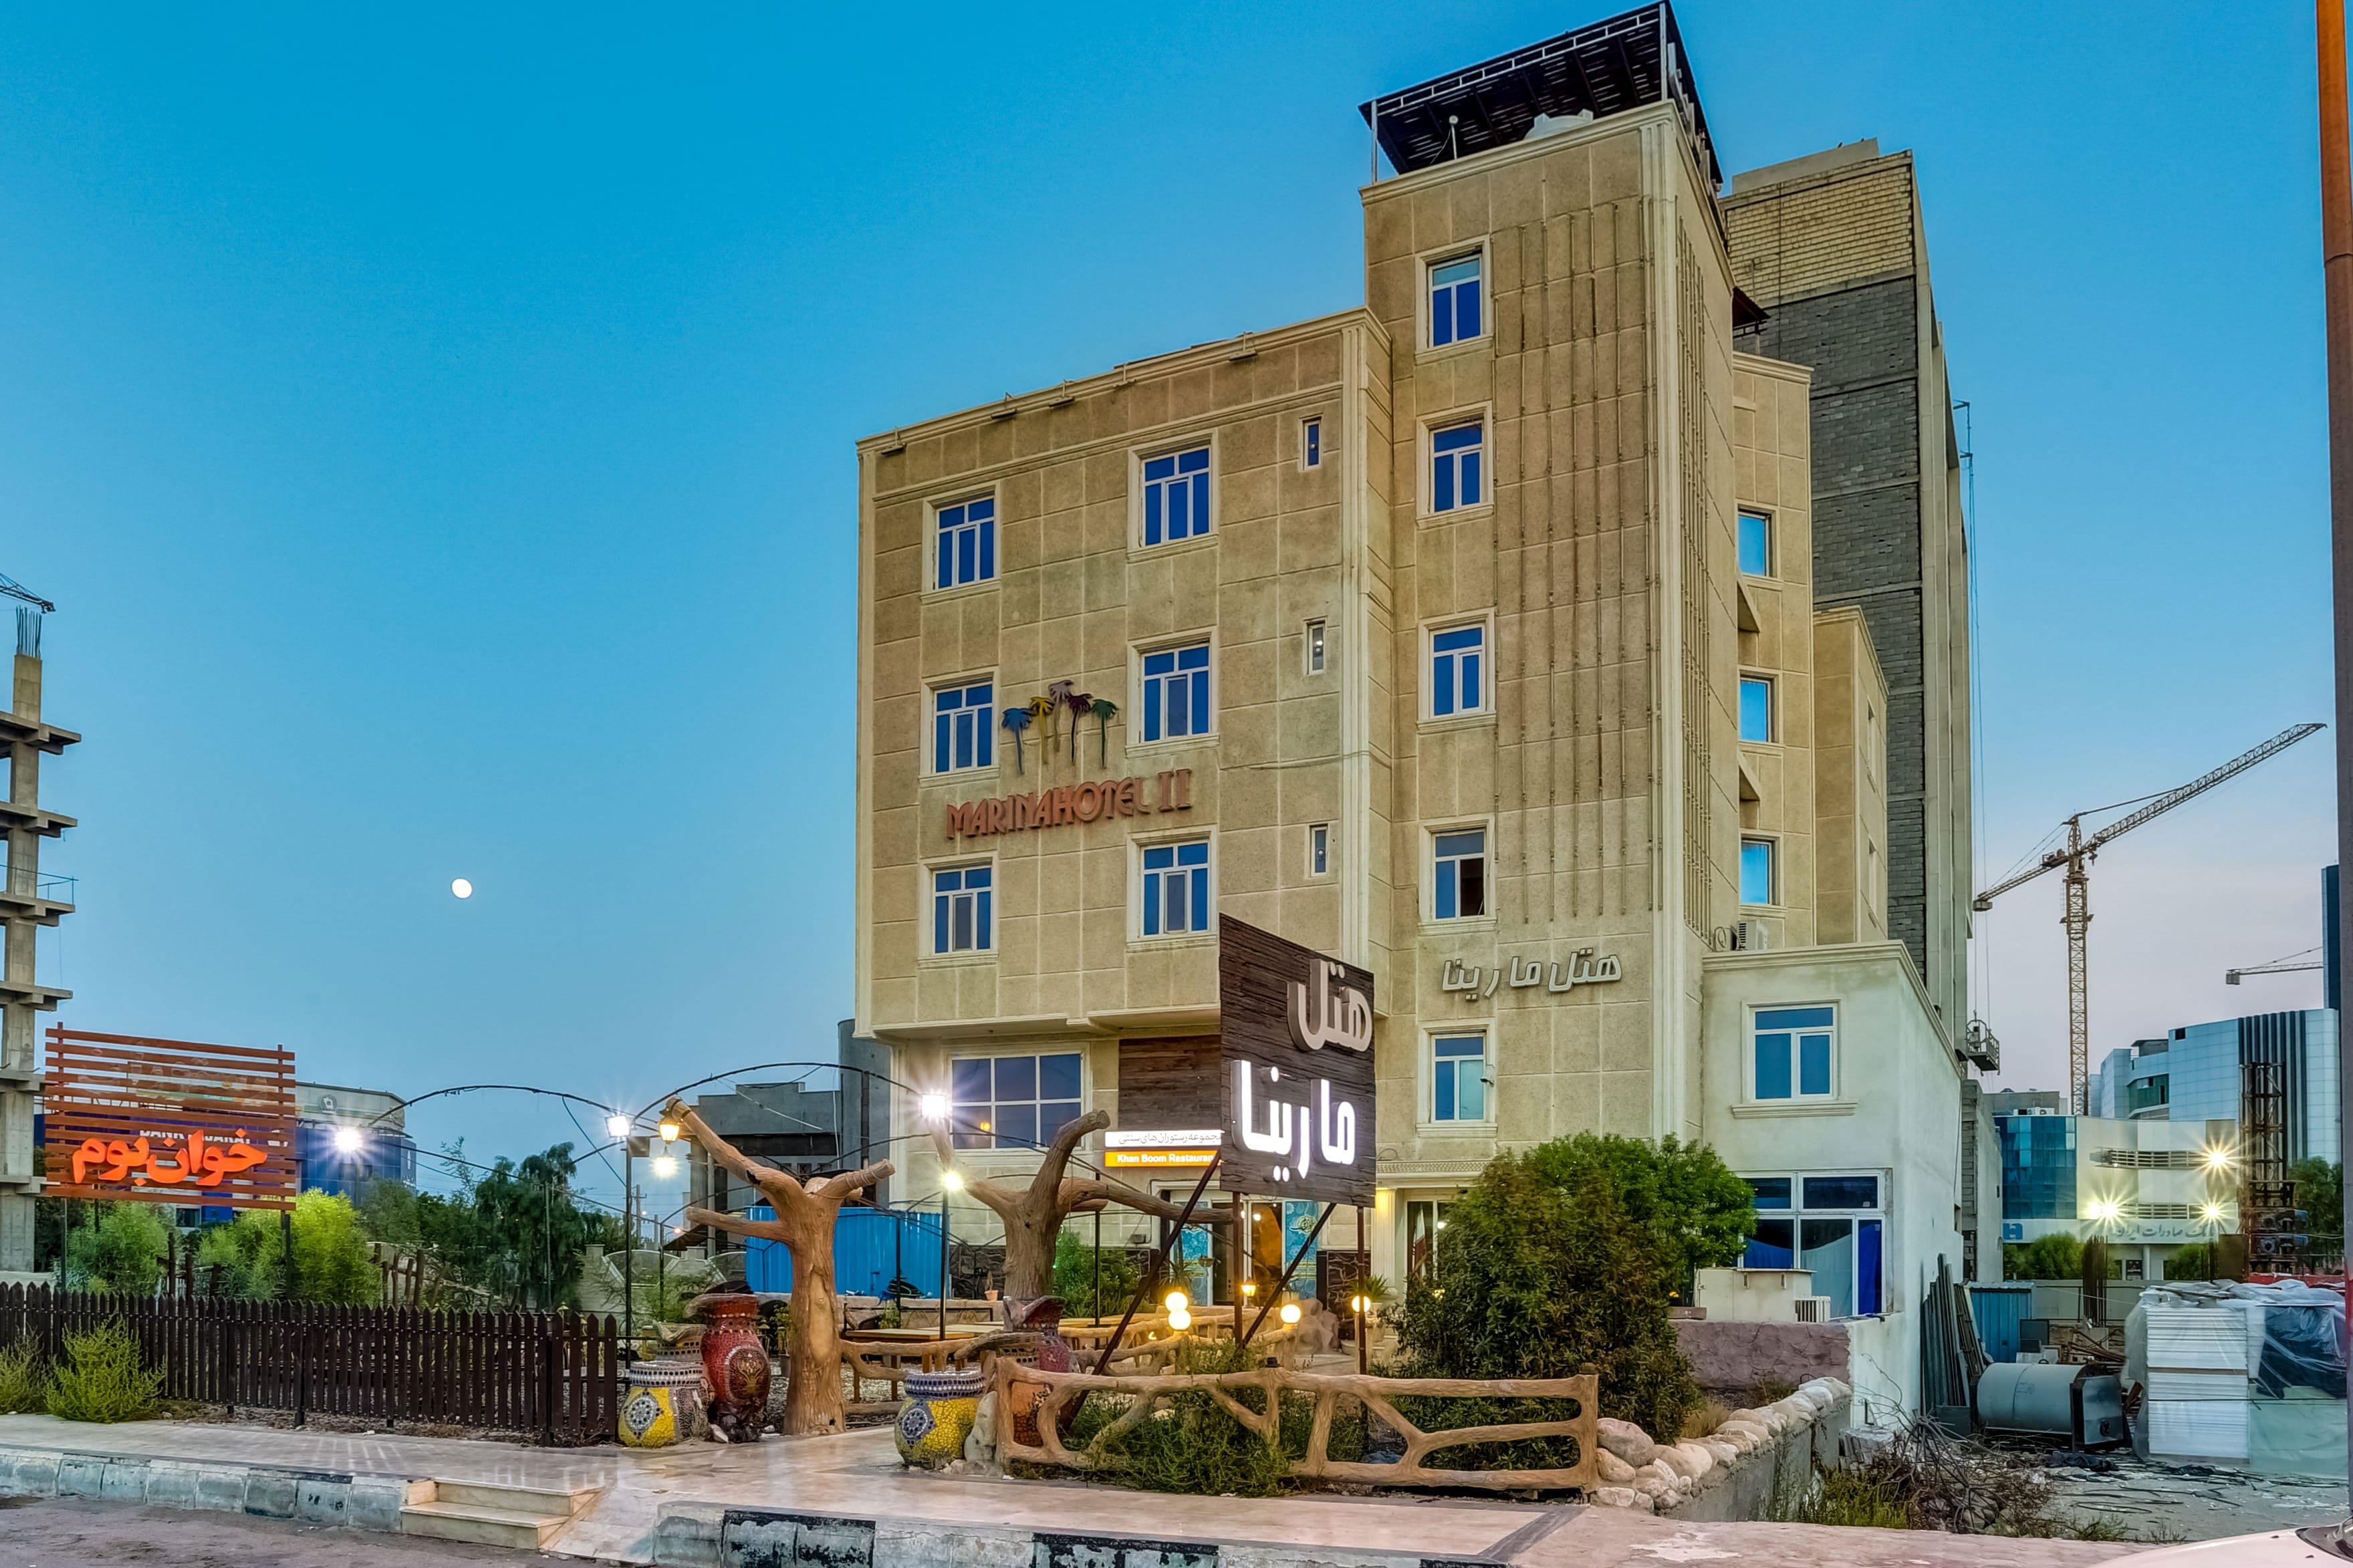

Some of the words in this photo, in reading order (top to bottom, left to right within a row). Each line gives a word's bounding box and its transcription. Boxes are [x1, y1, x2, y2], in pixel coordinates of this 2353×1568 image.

[1548, 947, 1622, 993] هتل
[1287, 958, 1372, 1053] هتل
[145, 1128, 267, 1186] خوان
[1117, 1154, 1140, 1163] Khan
[1141, 1154, 1167, 1163] Boom
[1168, 1153, 1216, 1163] Restauran
